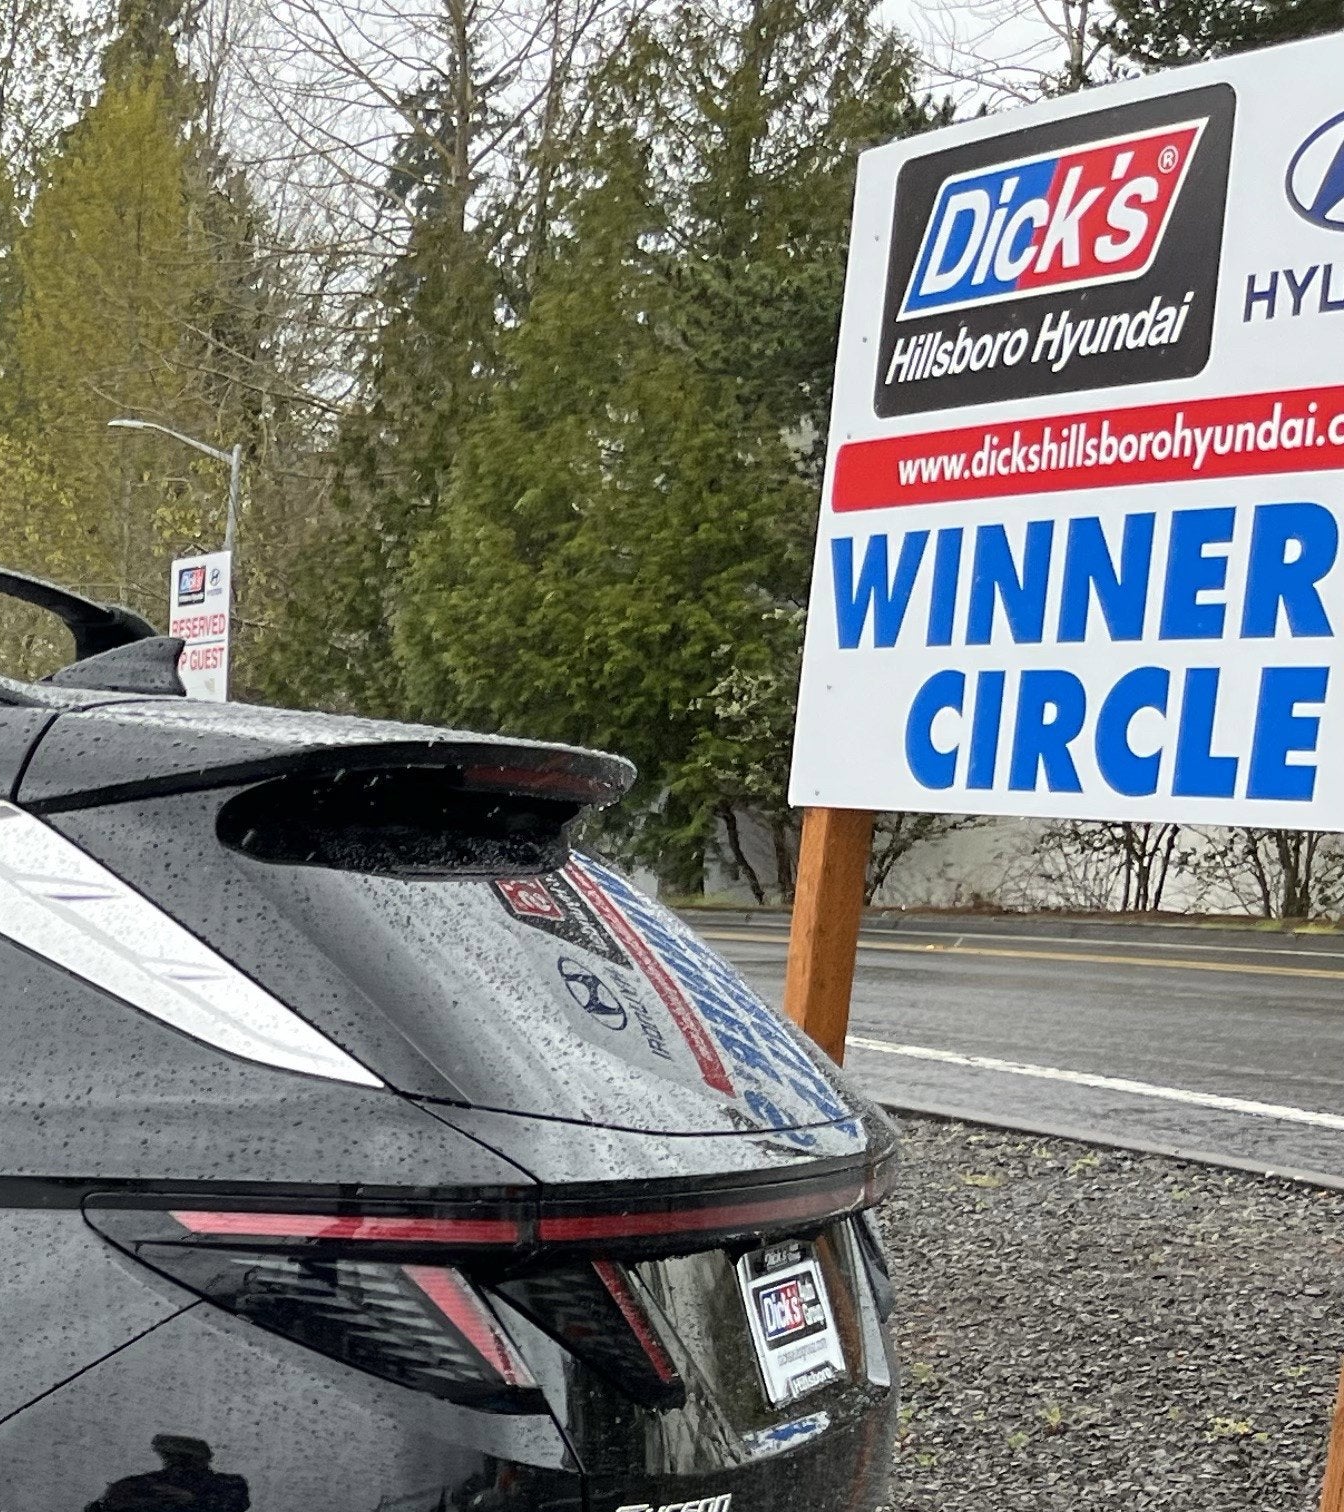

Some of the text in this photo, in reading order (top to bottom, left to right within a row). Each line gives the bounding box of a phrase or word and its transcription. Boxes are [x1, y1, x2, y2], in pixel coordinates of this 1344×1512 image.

[884, 291, 1196, 386] Hillsboro Hyundai
[830, 502, 1340, 650] WINNER
[172, 613, 226, 639] RESERVED
[190, 647, 225, 671] GUEST
[904, 665, 1331, 802] CIRCLE
